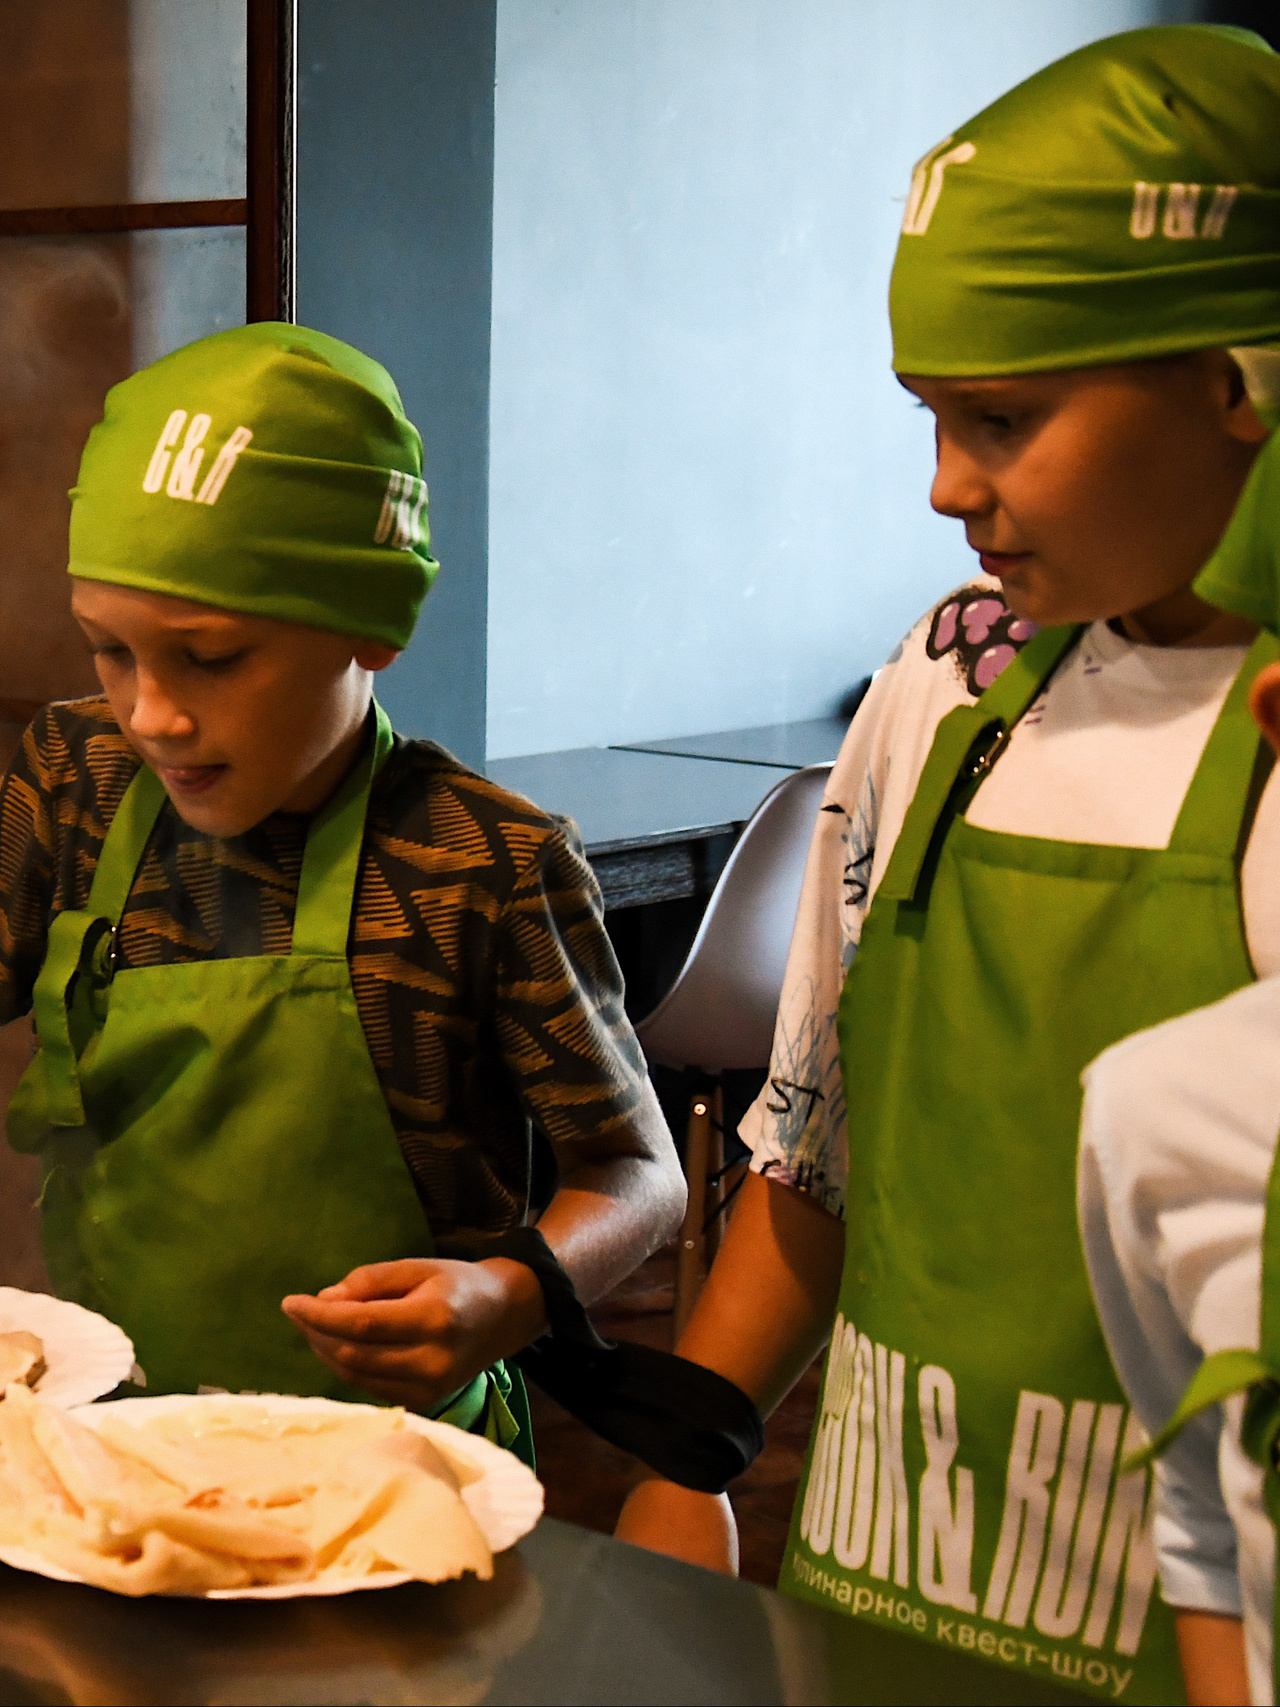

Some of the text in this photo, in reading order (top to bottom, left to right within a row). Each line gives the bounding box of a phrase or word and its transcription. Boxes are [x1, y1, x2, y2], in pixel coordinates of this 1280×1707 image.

[143, 409, 253, 506] C&R
[917, 1364, 978, 1614] &
[936, 1616, 1133, 1697] квест-шоу
